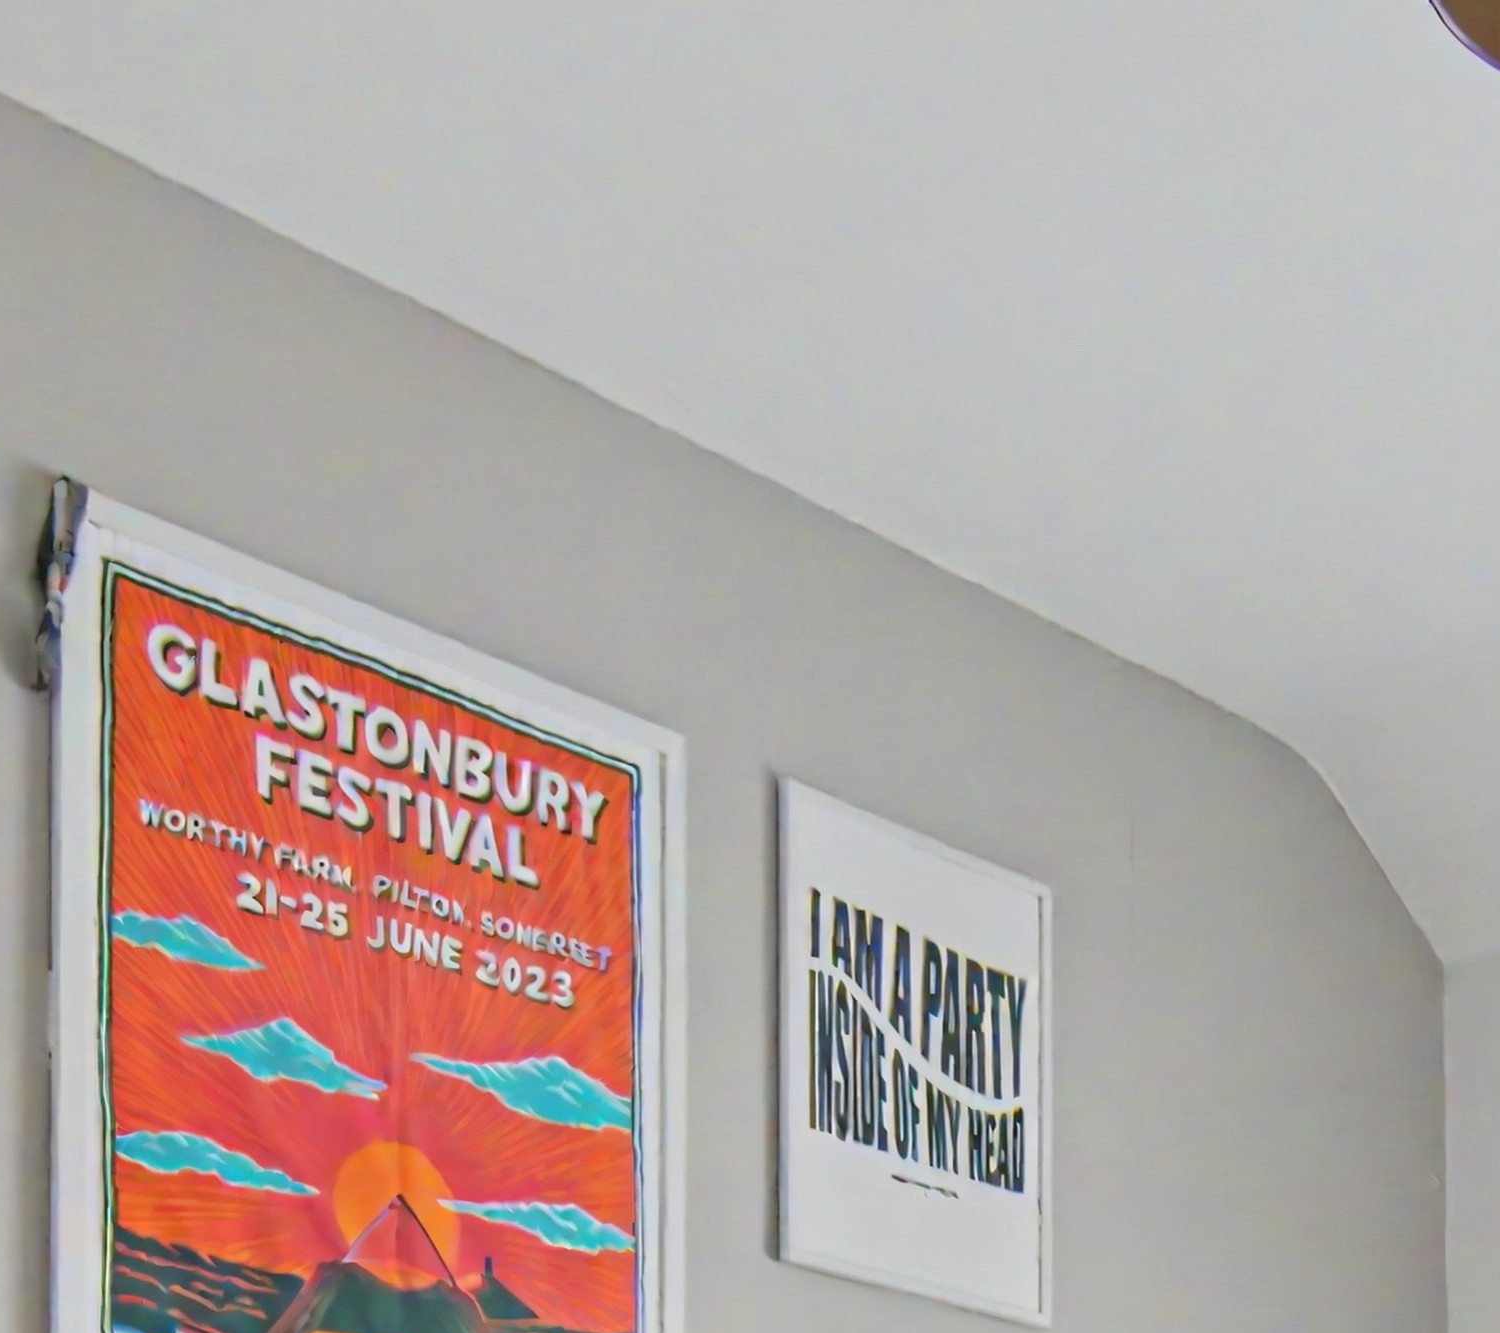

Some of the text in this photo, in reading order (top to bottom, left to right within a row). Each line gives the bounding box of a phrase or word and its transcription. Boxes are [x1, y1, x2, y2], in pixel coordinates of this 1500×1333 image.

[146, 621, 608, 844] GLASTONBURY
[255, 732, 541, 889] FESTIVAL
[139, 797, 268, 862] WORTHY
[235, 870, 576, 1010] 21-25 JUNE 2023
[809, 887, 1027, 1100] I AM A PARTY
[809, 968, 1025, 1193] INSIDE OF MY HEAD
